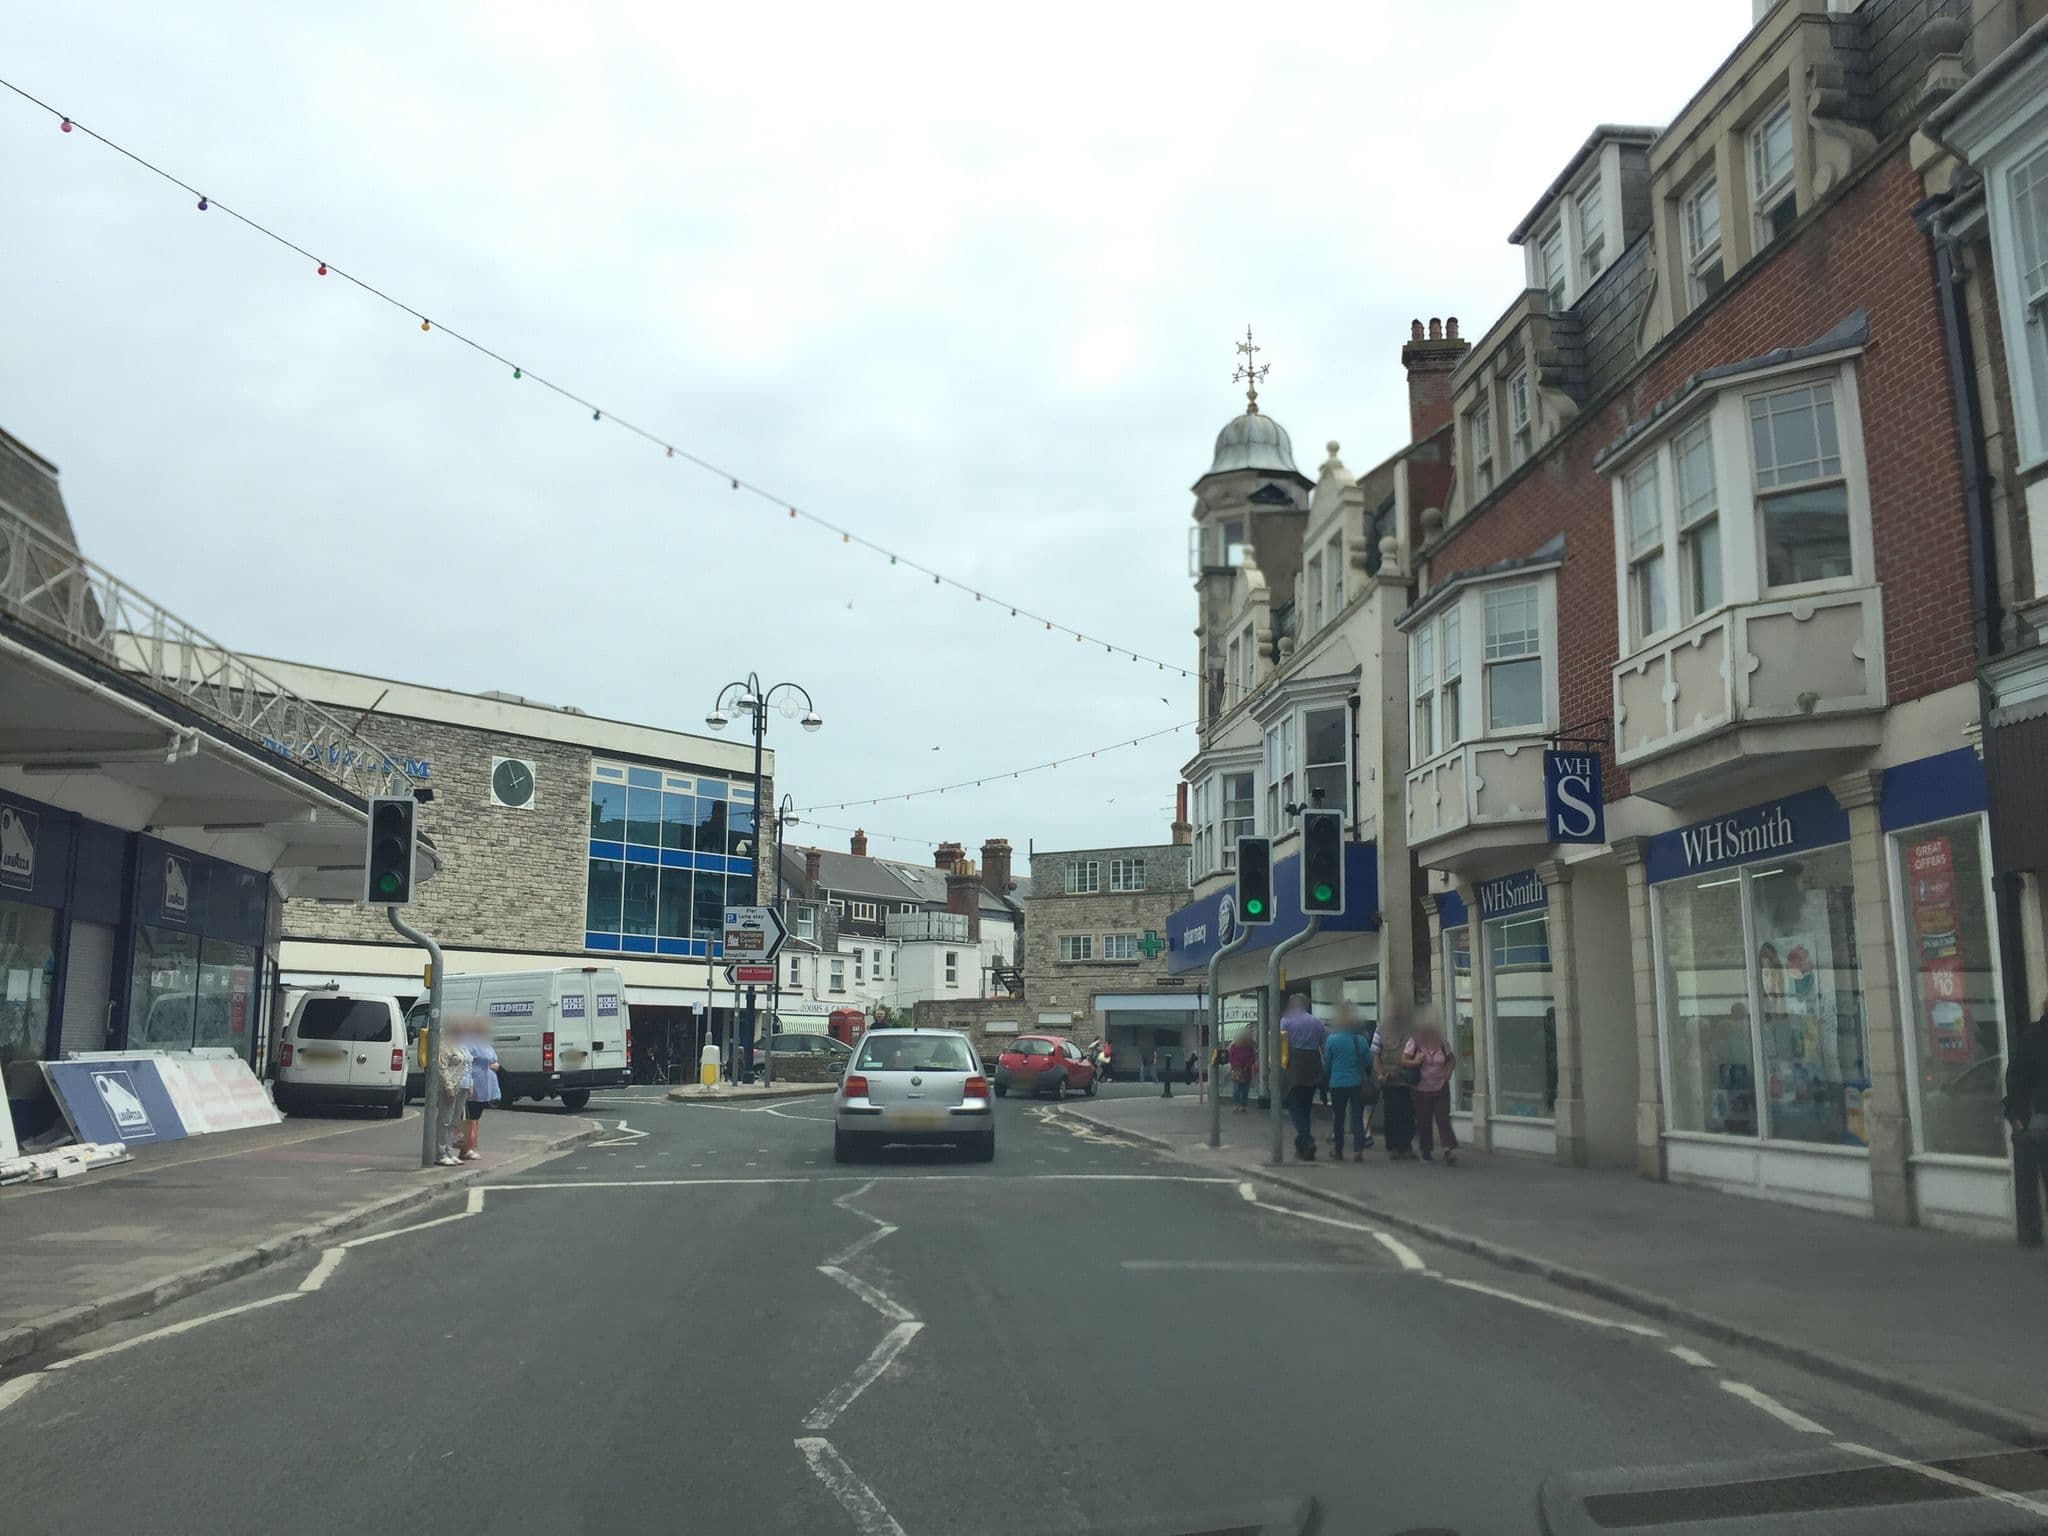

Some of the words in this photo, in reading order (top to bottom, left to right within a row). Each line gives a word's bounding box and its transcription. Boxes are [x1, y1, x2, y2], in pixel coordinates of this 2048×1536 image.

[1553, 757, 1592, 775] WH
[1557, 775, 1597, 837] S
[1681, 806, 1794, 867] WHSmith
[1916, 841, 1942, 857] GREAT
[1915, 853, 1946, 870] OFFERS
[1480, 872, 1544, 913] WHSmith
[1183, 923, 1207, 950] pharmacy
